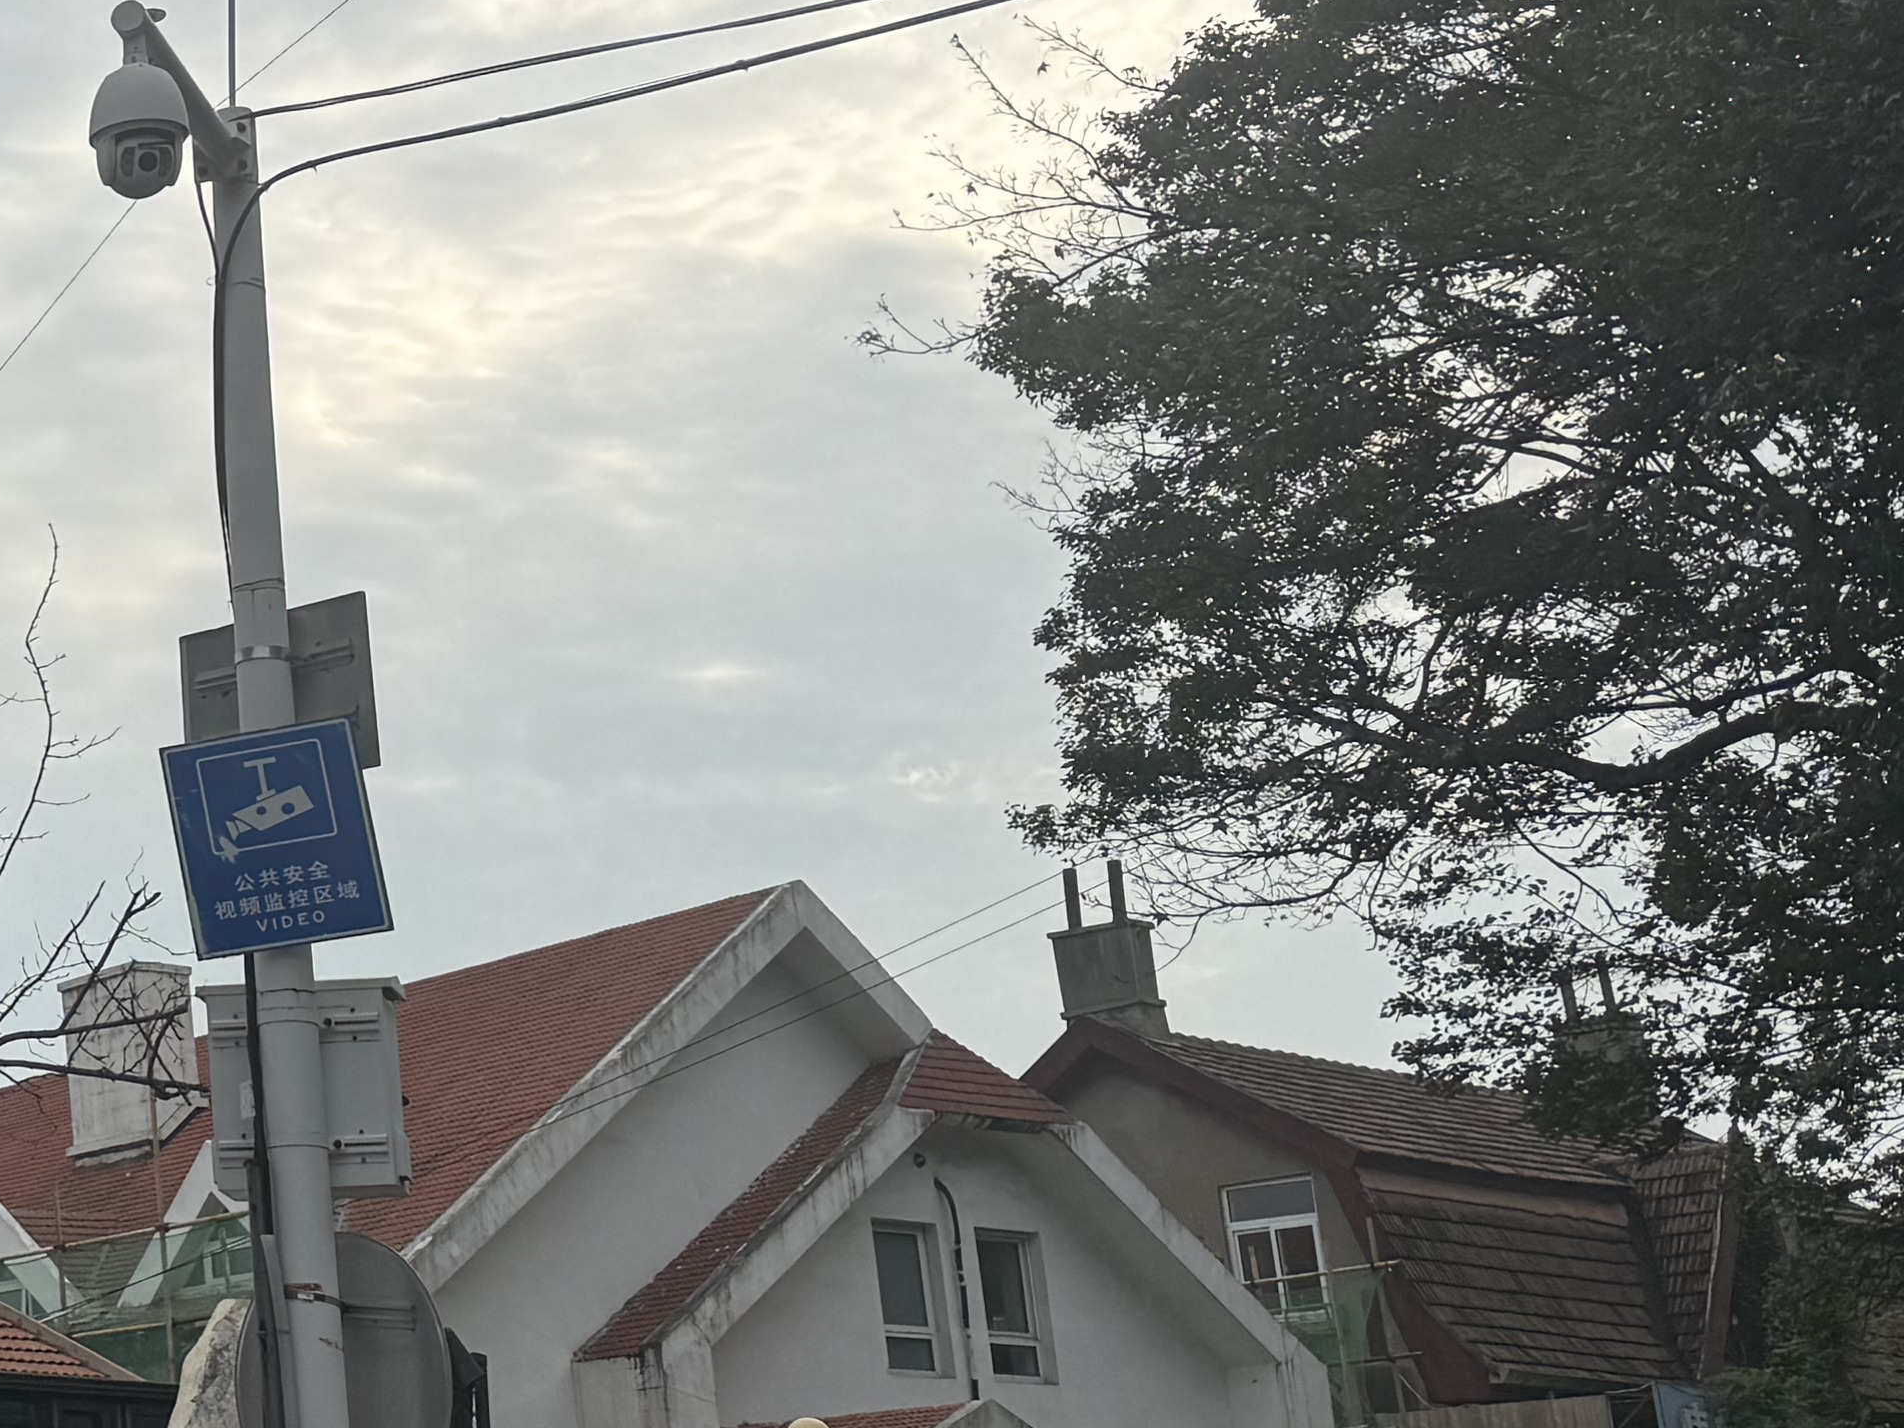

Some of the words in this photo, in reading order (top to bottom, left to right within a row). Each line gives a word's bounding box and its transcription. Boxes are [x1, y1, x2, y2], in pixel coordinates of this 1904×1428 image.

[234, 859, 330, 893] 公共安全
[213, 879, 360, 921] 视频监控区域
[255, 910, 326, 933] VIDEO
